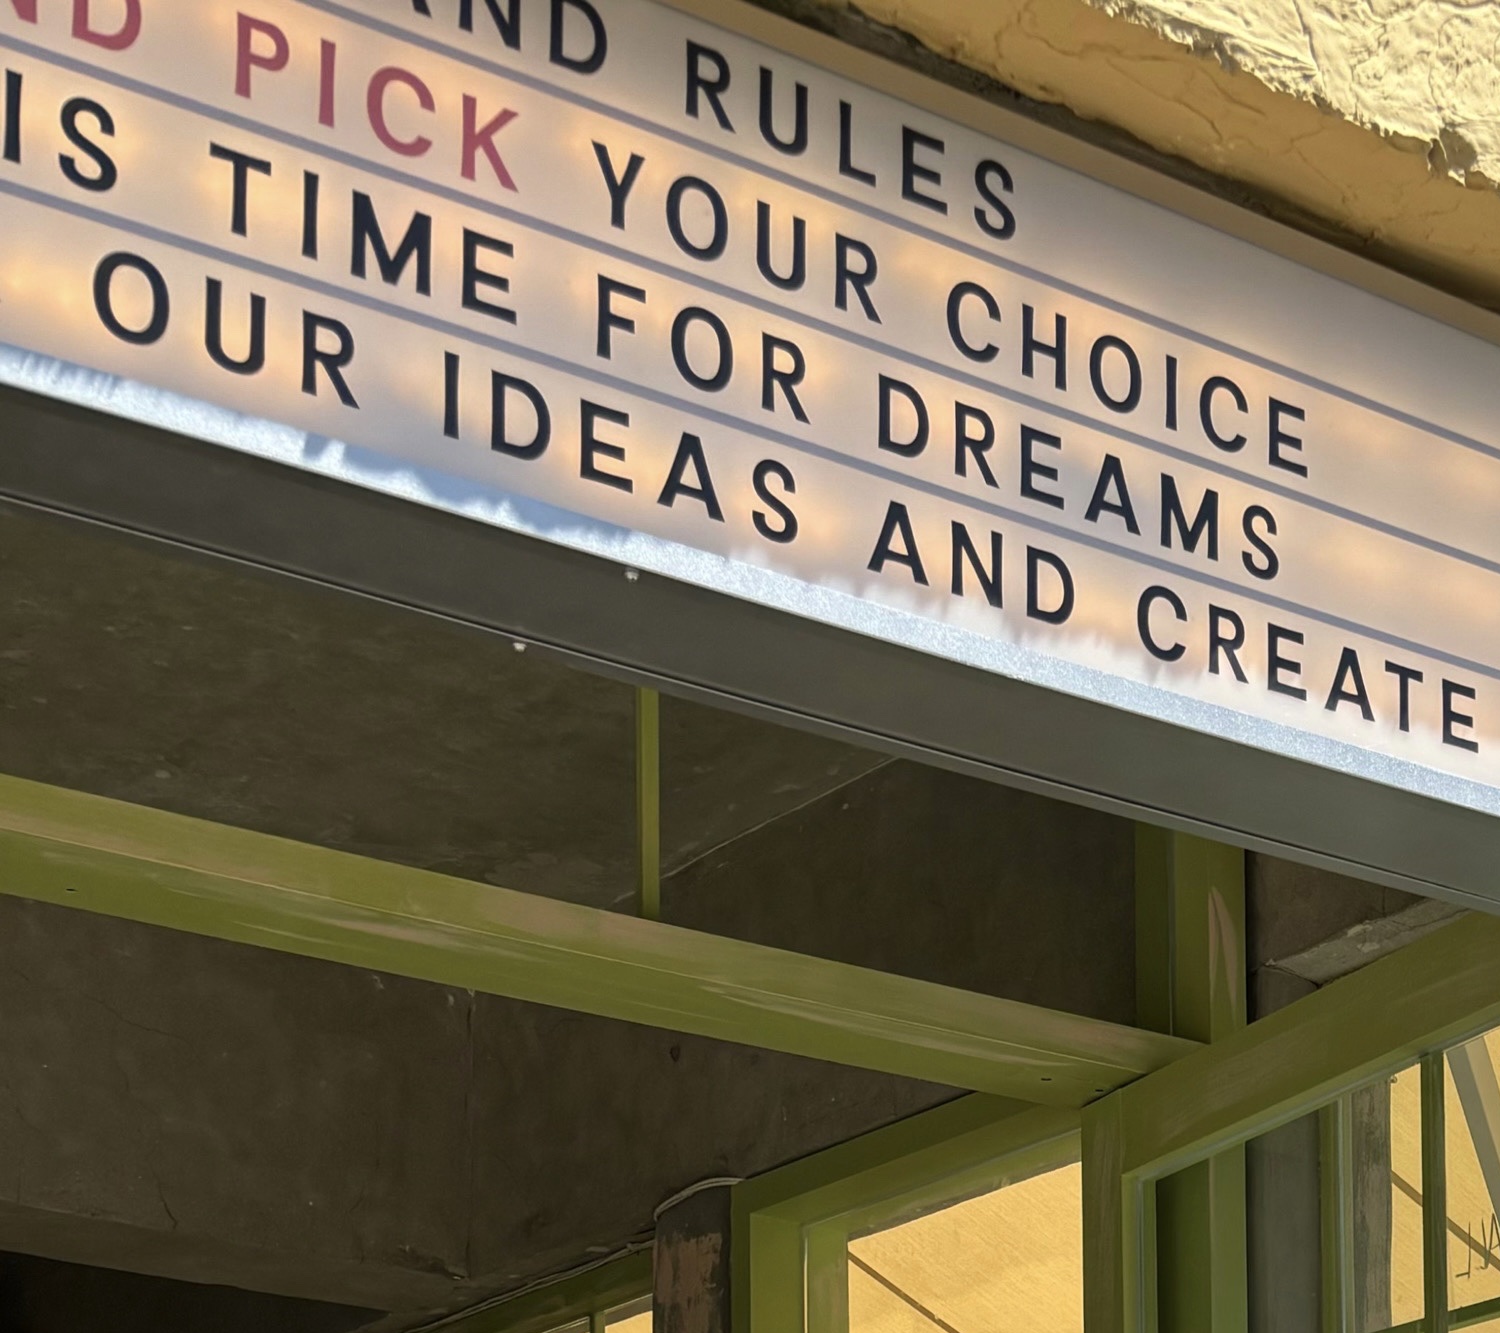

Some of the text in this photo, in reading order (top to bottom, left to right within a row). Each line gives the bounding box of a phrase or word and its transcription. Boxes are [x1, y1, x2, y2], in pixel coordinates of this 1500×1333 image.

[4, 69, 1281, 581] IS TIME FOR DREAMS
[233, 11, 520, 193] PICK
[591, 140, 882, 324] YOUR
[946, 281, 1309, 478] CHOICE
[409, 0, 1017, 239] ND RULES
[93, 250, 1481, 754] OUR IDEAS AND CREATE
